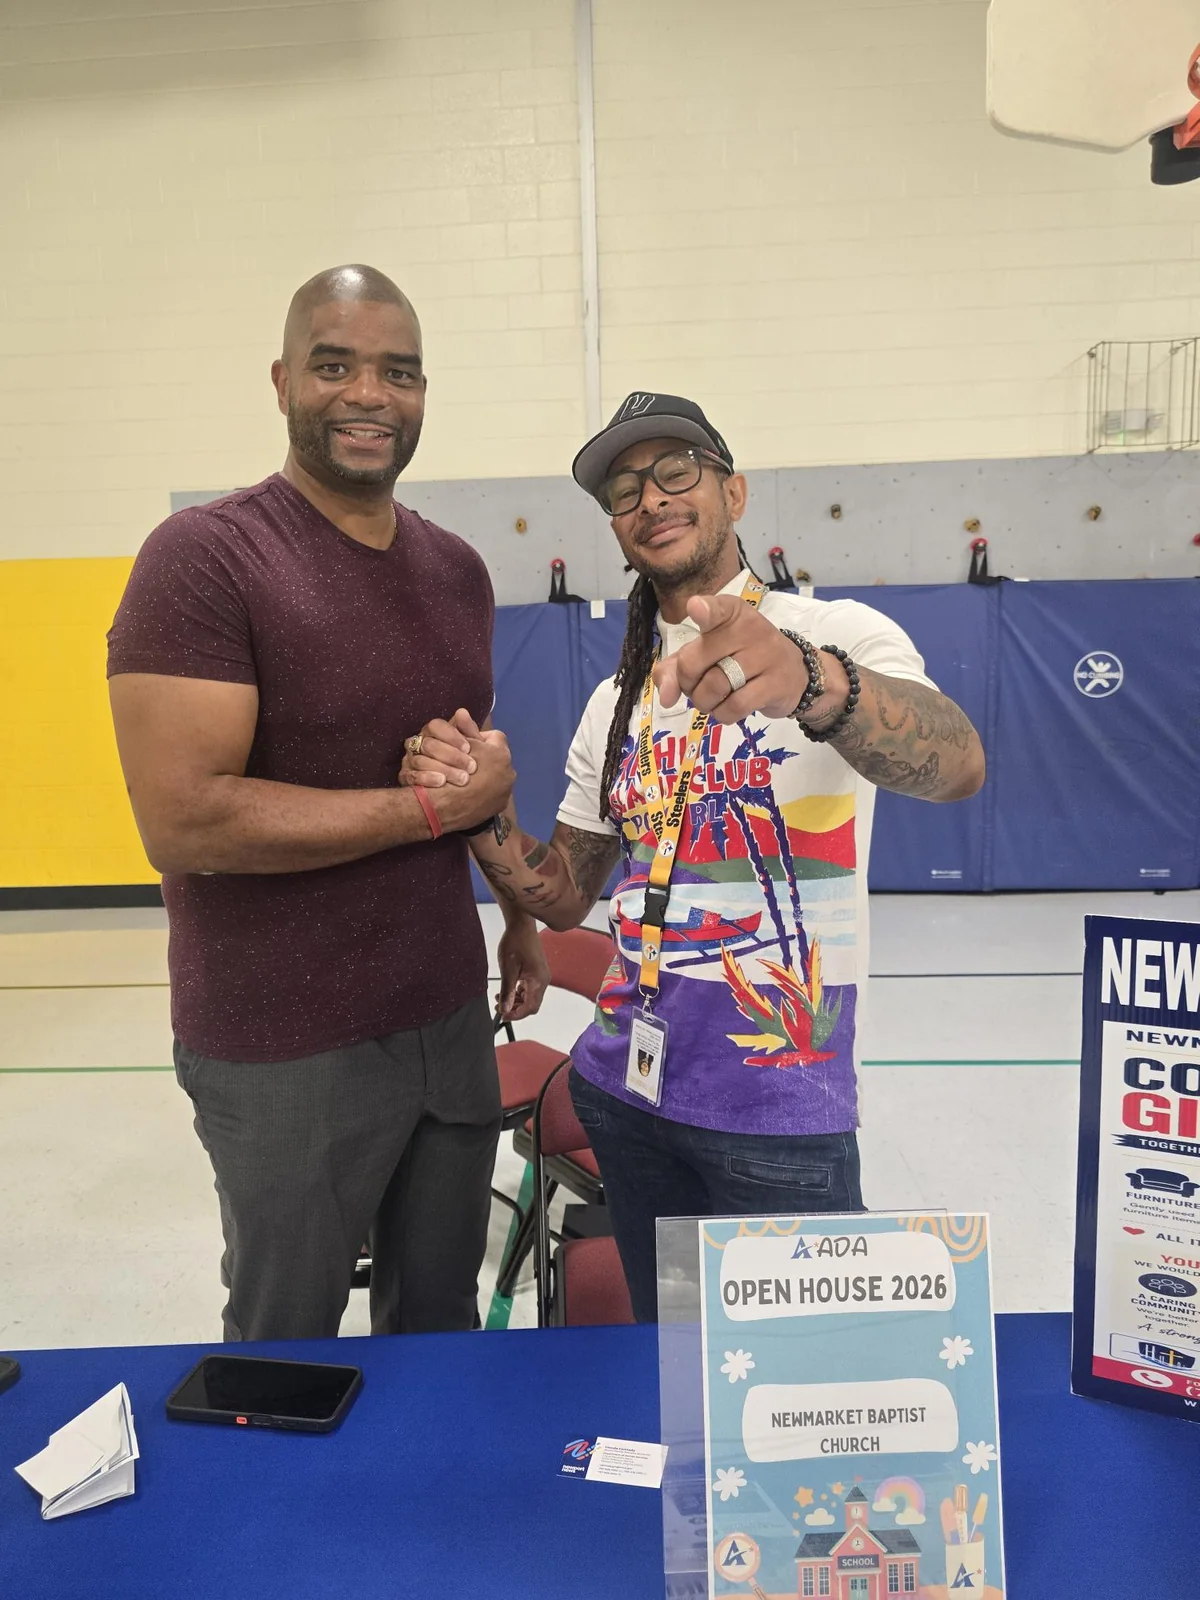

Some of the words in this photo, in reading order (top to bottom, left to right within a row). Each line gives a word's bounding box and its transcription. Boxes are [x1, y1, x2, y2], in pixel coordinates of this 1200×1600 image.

[639, 725, 652, 776] Steelers
[689, 756, 772, 794] CLUB
[666, 770, 691, 828] Steelers
[1101, 936, 1200, 1013] NEW
[1123, 1057, 1200, 1097] CO
[1122, 1091, 1198, 1138] GI
[1126, 1191, 1200, 1209] FURNITURE
[1123, 1207, 1169, 1219] furniture
[1130, 1202, 1165, 1213] Gently
[1168, 1209, 1195, 1218] used
[817, 1236, 868, 1258] ADA
[1156, 1232, 1184, 1244] ALL
[1134, 1260, 1153, 1268] WE
[1157, 1264, 1200, 1277] WOULD
[723, 1278, 791, 1306] OPEN
[799, 1275, 884, 1304] HOUSE
[892, 1274, 947, 1300] 2026
[1131, 1298, 1200, 1316] COMMUNIT
[1150, 1295, 1196, 1310] CARING
[1168, 1313, 1199, 1324] better
[771, 1409, 863, 1428] NEWMARKET
[867, 1406, 926, 1424] BAPTIST
[820, 1436, 880, 1454] CHURCH
[842, 1557, 875, 1567] SCHOOL
